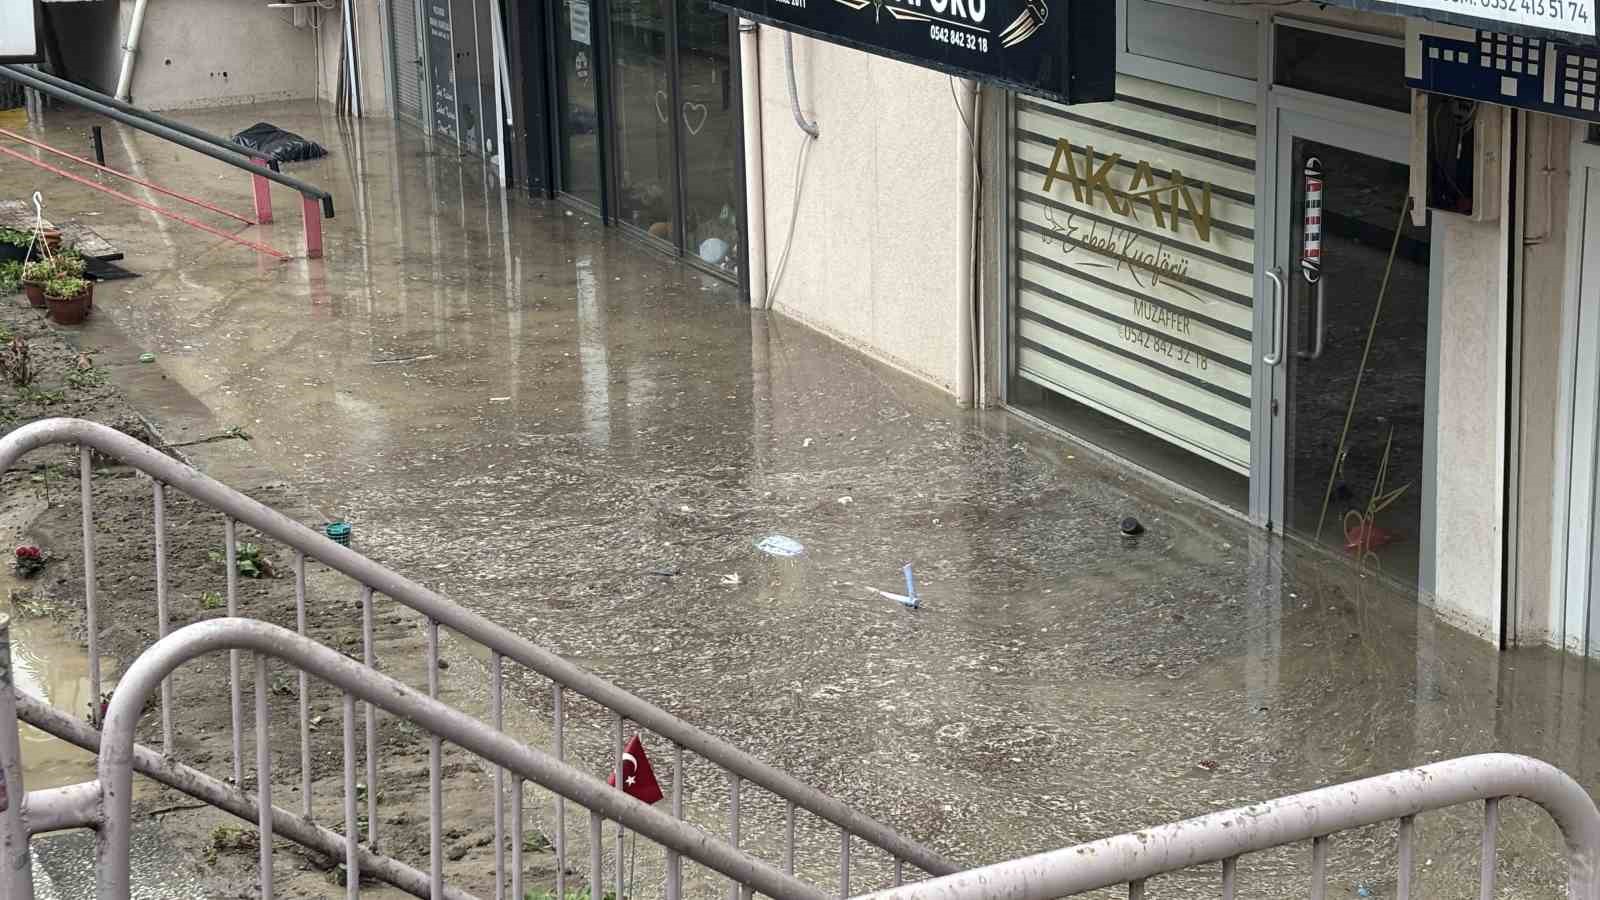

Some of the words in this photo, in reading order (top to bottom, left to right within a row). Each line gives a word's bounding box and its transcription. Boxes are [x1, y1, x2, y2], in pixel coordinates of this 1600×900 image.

[1521, 0, 1545, 16] 413
[1549, 0, 1564, 20] 51
[1568, 2, 1589, 24] 74
[930, 24, 949, 43] 0542
[950, 29, 965, 47] 842
[966, 33, 977, 50] 32
[977, 36, 988, 53] 18
[1042, 137, 1212, 242] AKAN
[1133, 297, 1192, 336] MUZAFFER
[1124, 324, 1150, 349] 0542
[1153, 336, 1173, 358] 842
[1177, 344, 1192, 364] 32
[1195, 351, 1208, 370] 18
